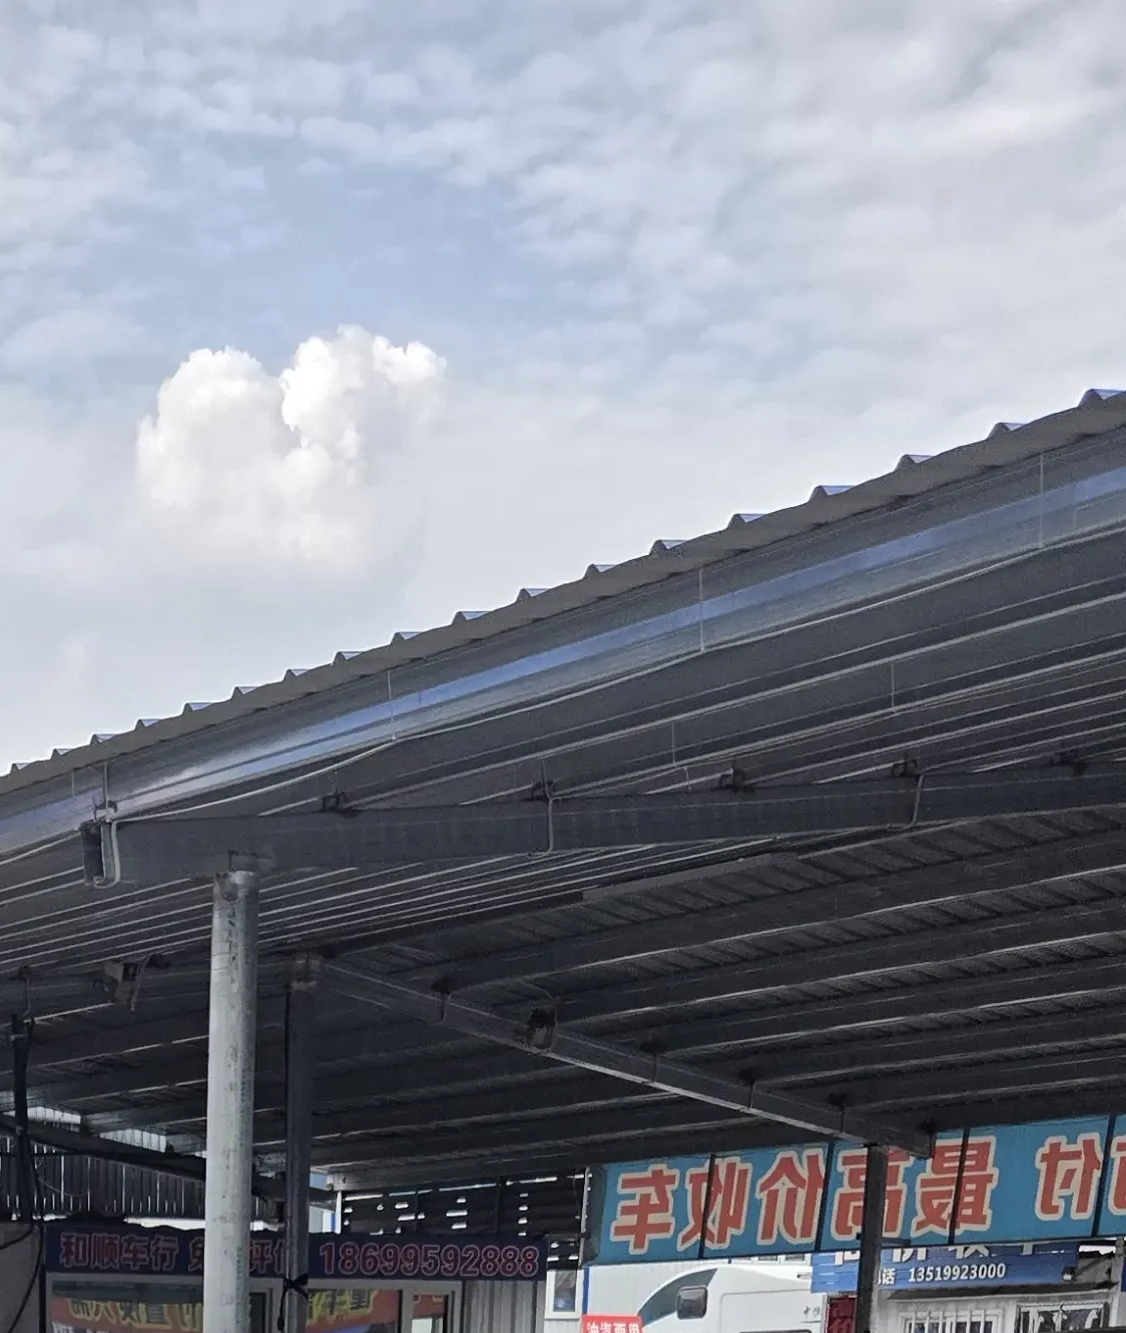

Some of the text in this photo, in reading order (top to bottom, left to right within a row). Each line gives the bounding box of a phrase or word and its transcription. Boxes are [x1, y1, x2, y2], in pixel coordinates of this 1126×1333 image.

[59, 1231, 180, 1271] 和顺车行
[320, 1242, 540, 1277] 18699592888
[908, 1262, 1006, 1284] 13519923000
